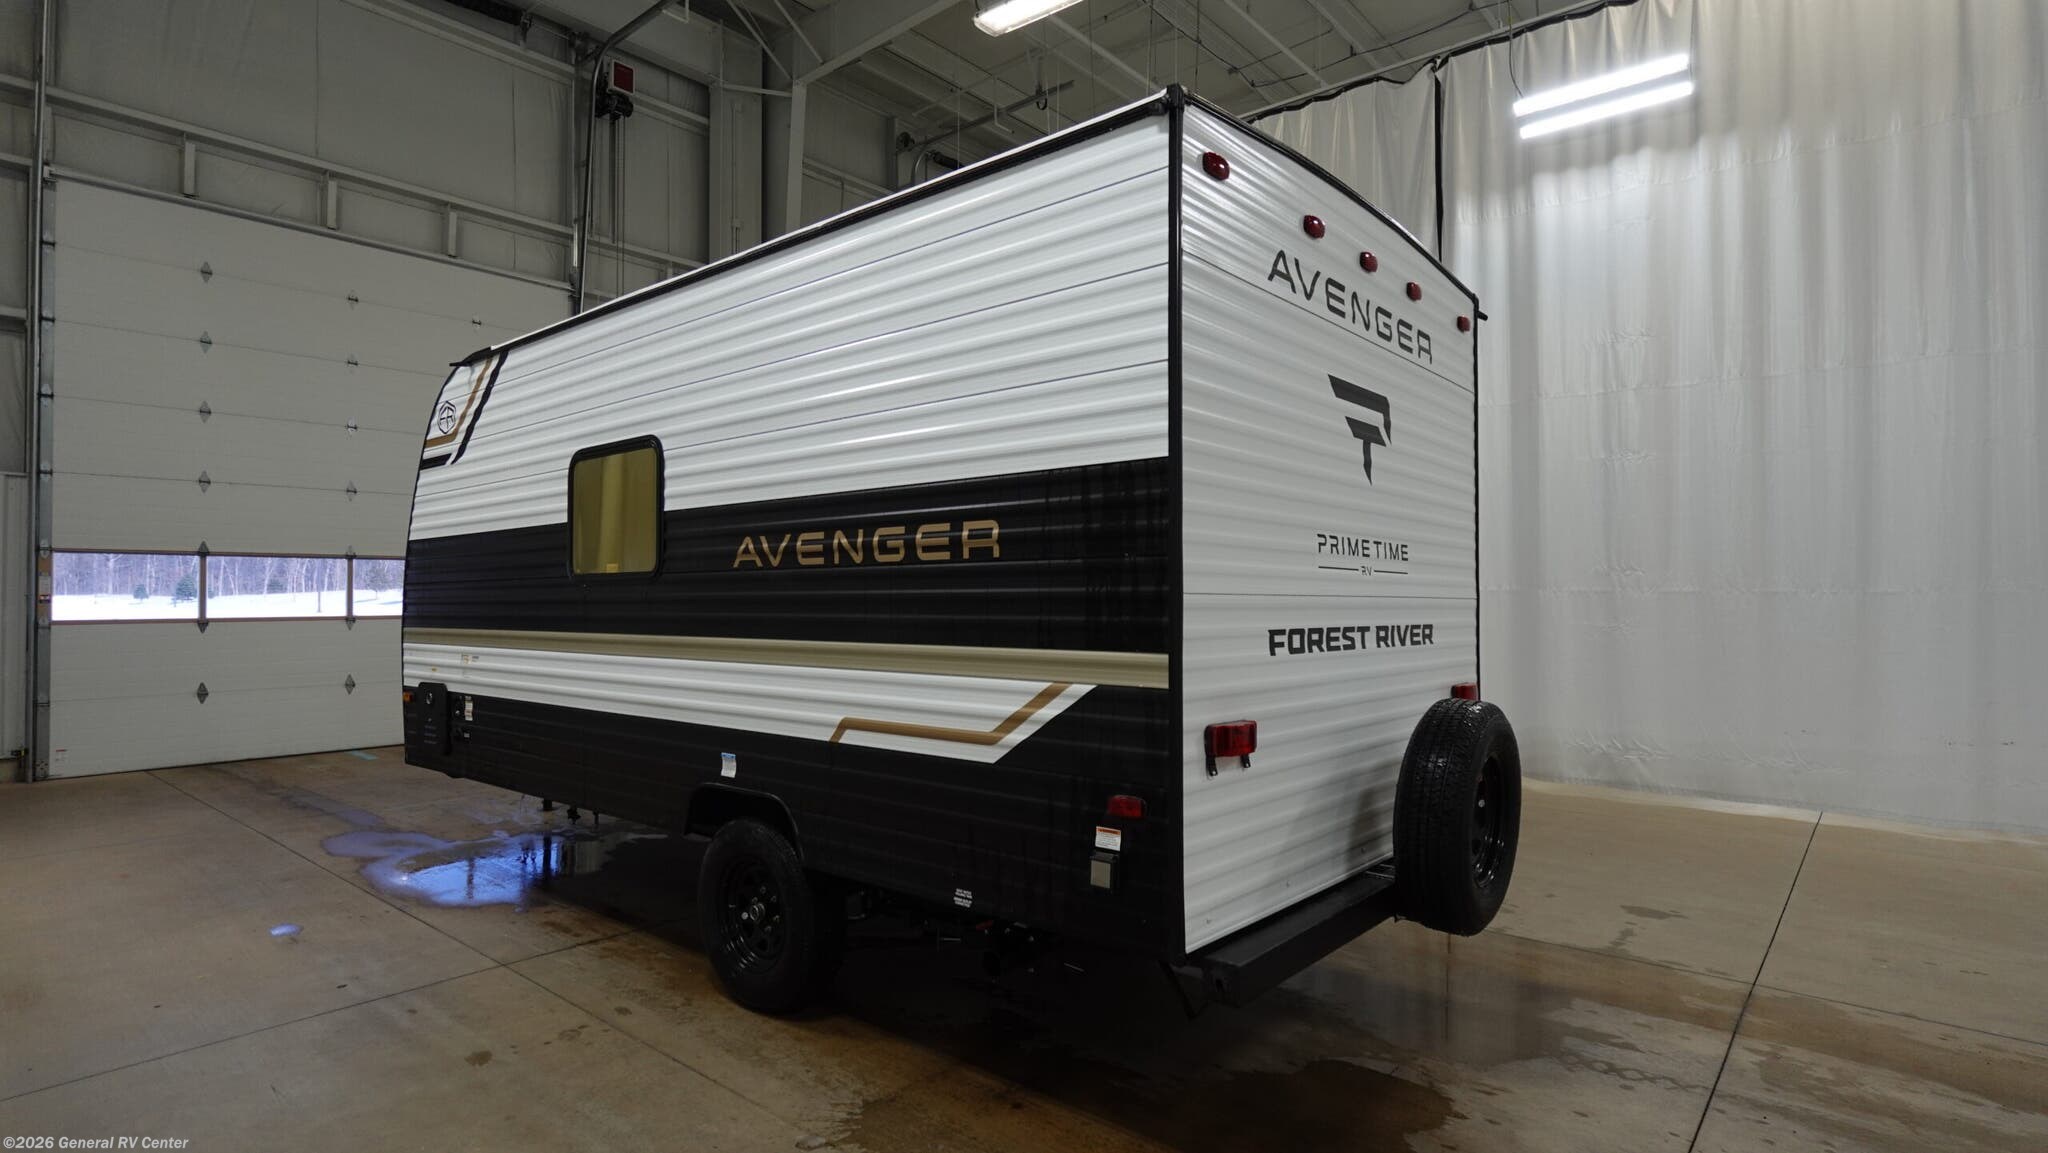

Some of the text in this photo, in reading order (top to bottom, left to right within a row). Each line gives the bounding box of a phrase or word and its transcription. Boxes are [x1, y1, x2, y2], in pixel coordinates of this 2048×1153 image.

[1268, 249, 1432, 364] AVENGER
[733, 519, 1000, 568] AVENGER
[1360, 565, 1373, 576] RV
[1268, 623, 1434, 657] FOREST RIVER
